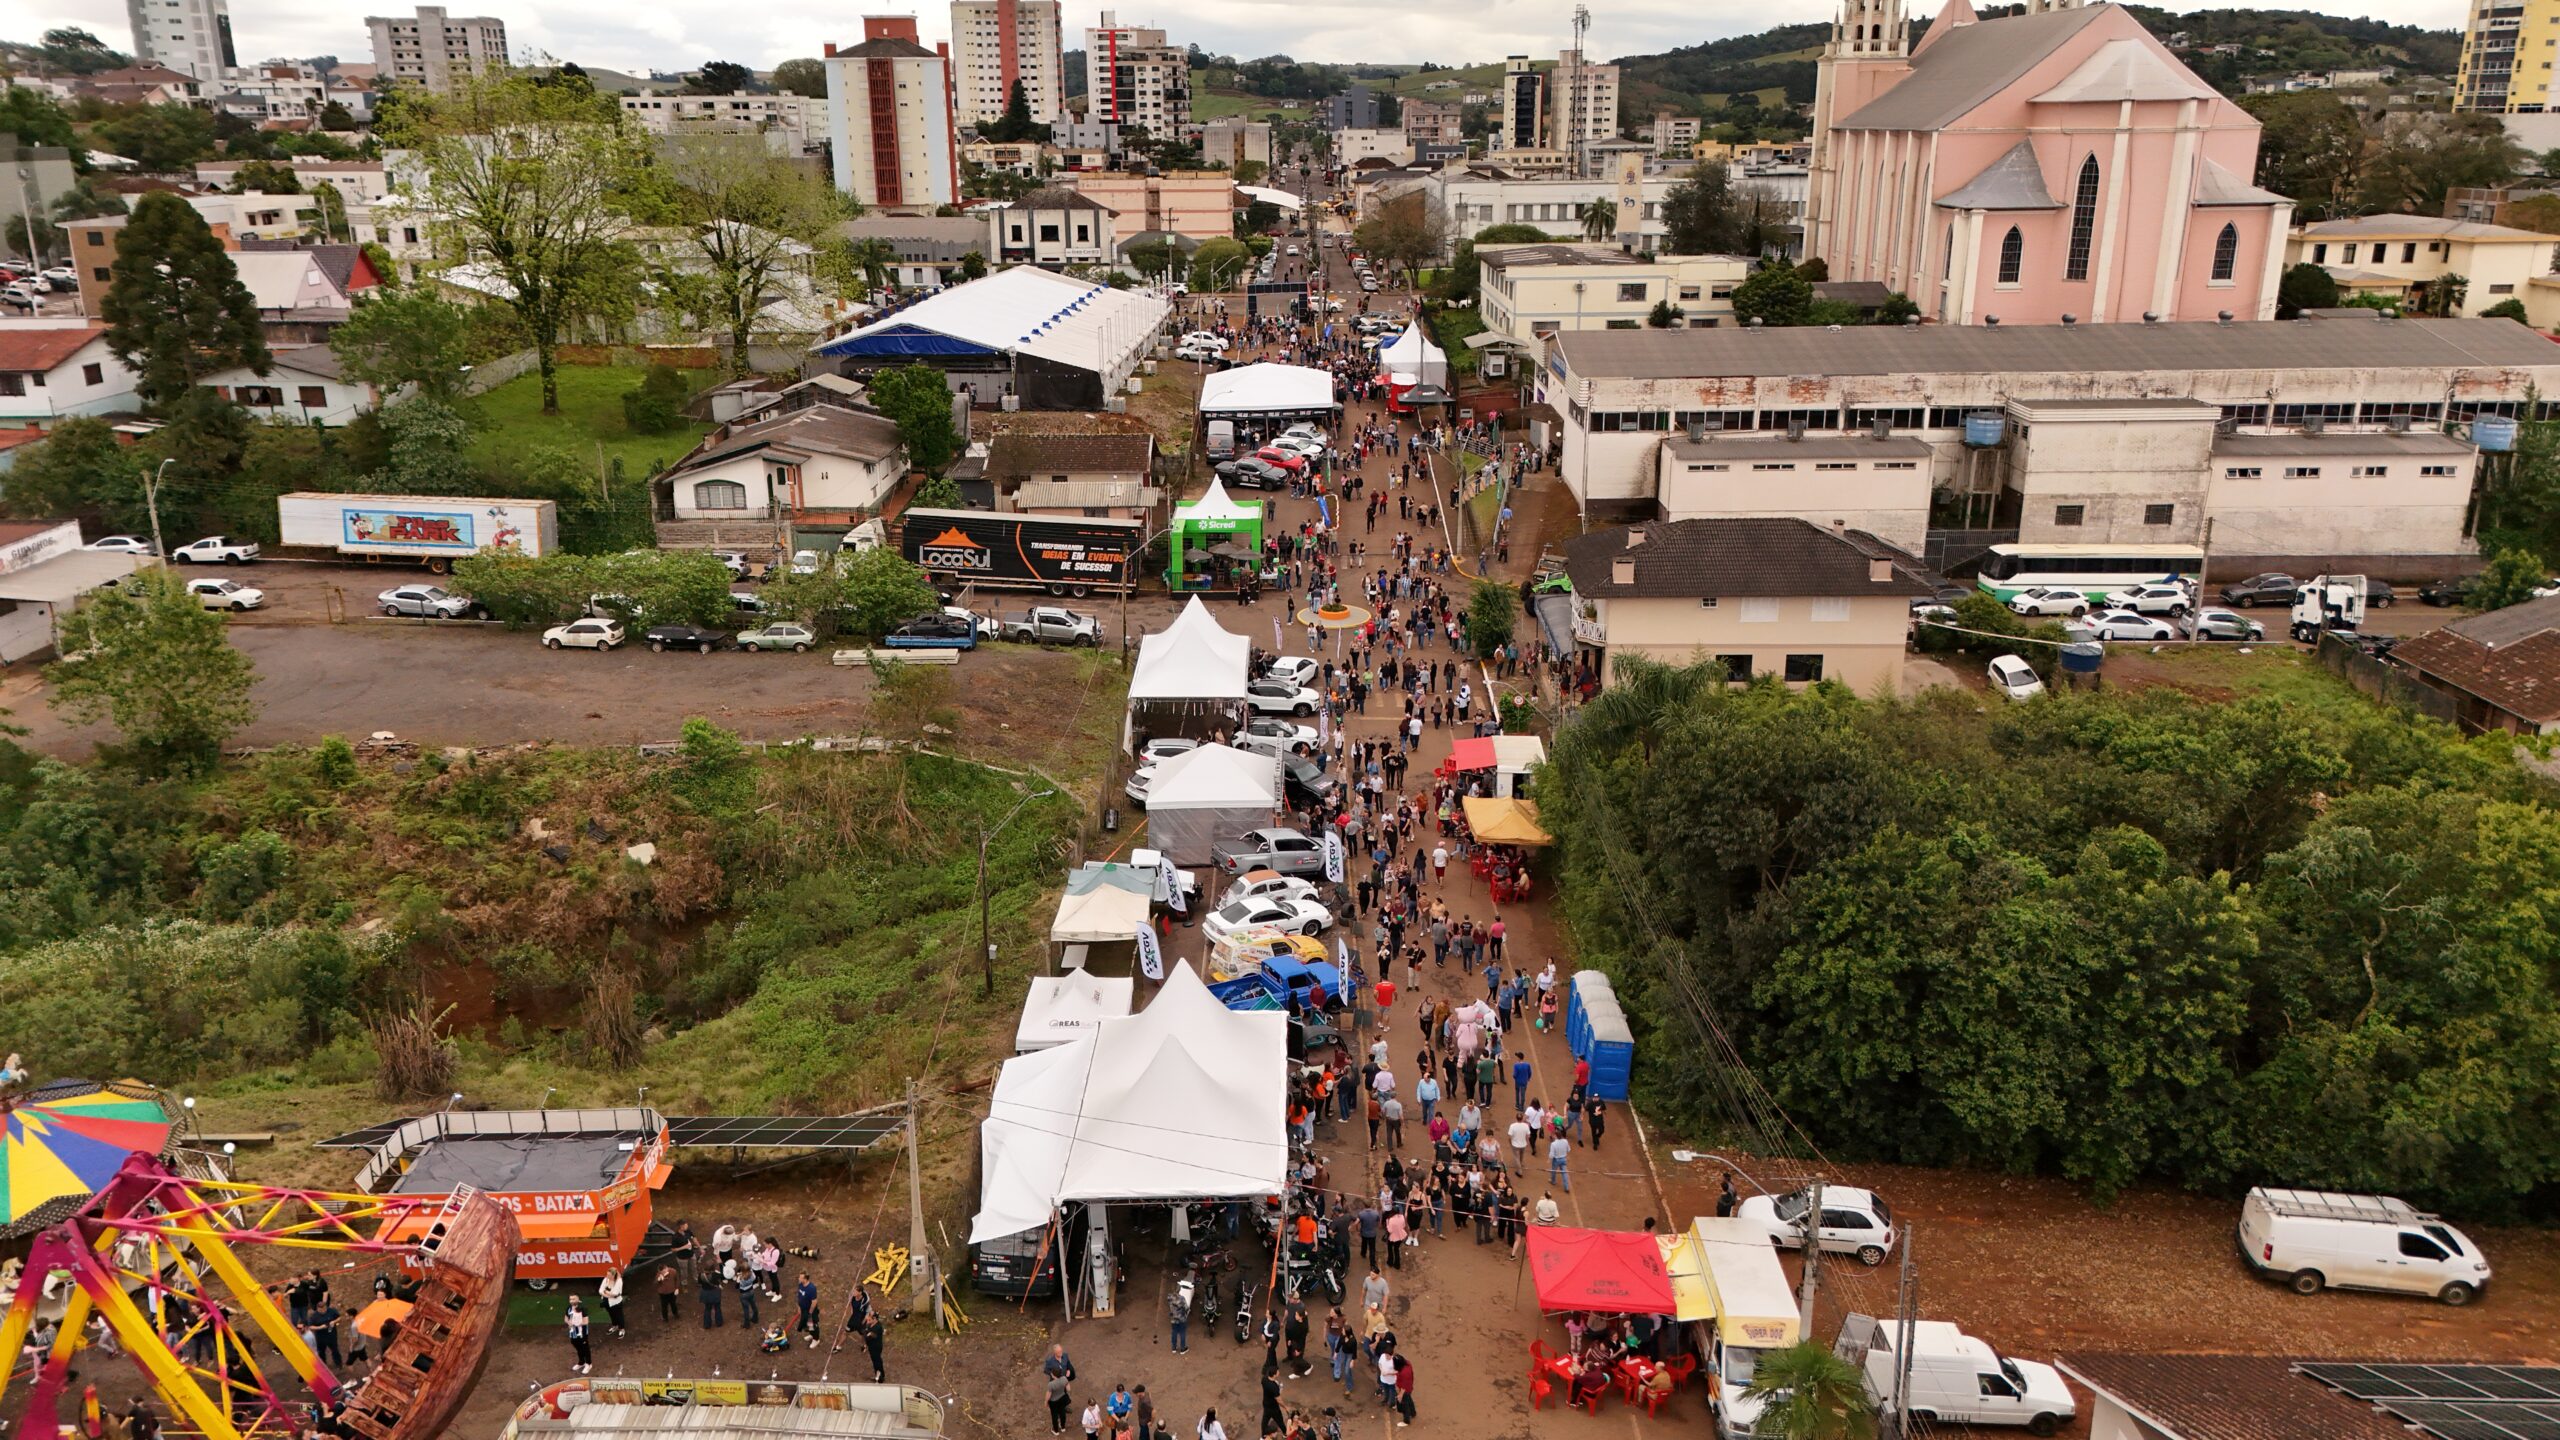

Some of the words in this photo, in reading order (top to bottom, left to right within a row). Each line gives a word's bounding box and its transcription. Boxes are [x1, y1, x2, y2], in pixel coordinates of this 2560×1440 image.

[1208, 520, 1236, 529] Sicredi
[389, 526, 461, 541] PARK
[1031, 542, 1084, 551] TRANSFORMANDO
[919, 545, 991, 568] LocaSul
[1042, 551, 1069, 560] IDEIAS
[1071, 552, 1086, 560] EM
[1088, 553, 1125, 563] EVENTOS
[1060, 562, 1072, 570] DE
[1074, 563, 1113, 572] SUCESSO!
[535, 1195, 595, 1212] BATATA
[557, 1251, 613, 1264] BATATA
